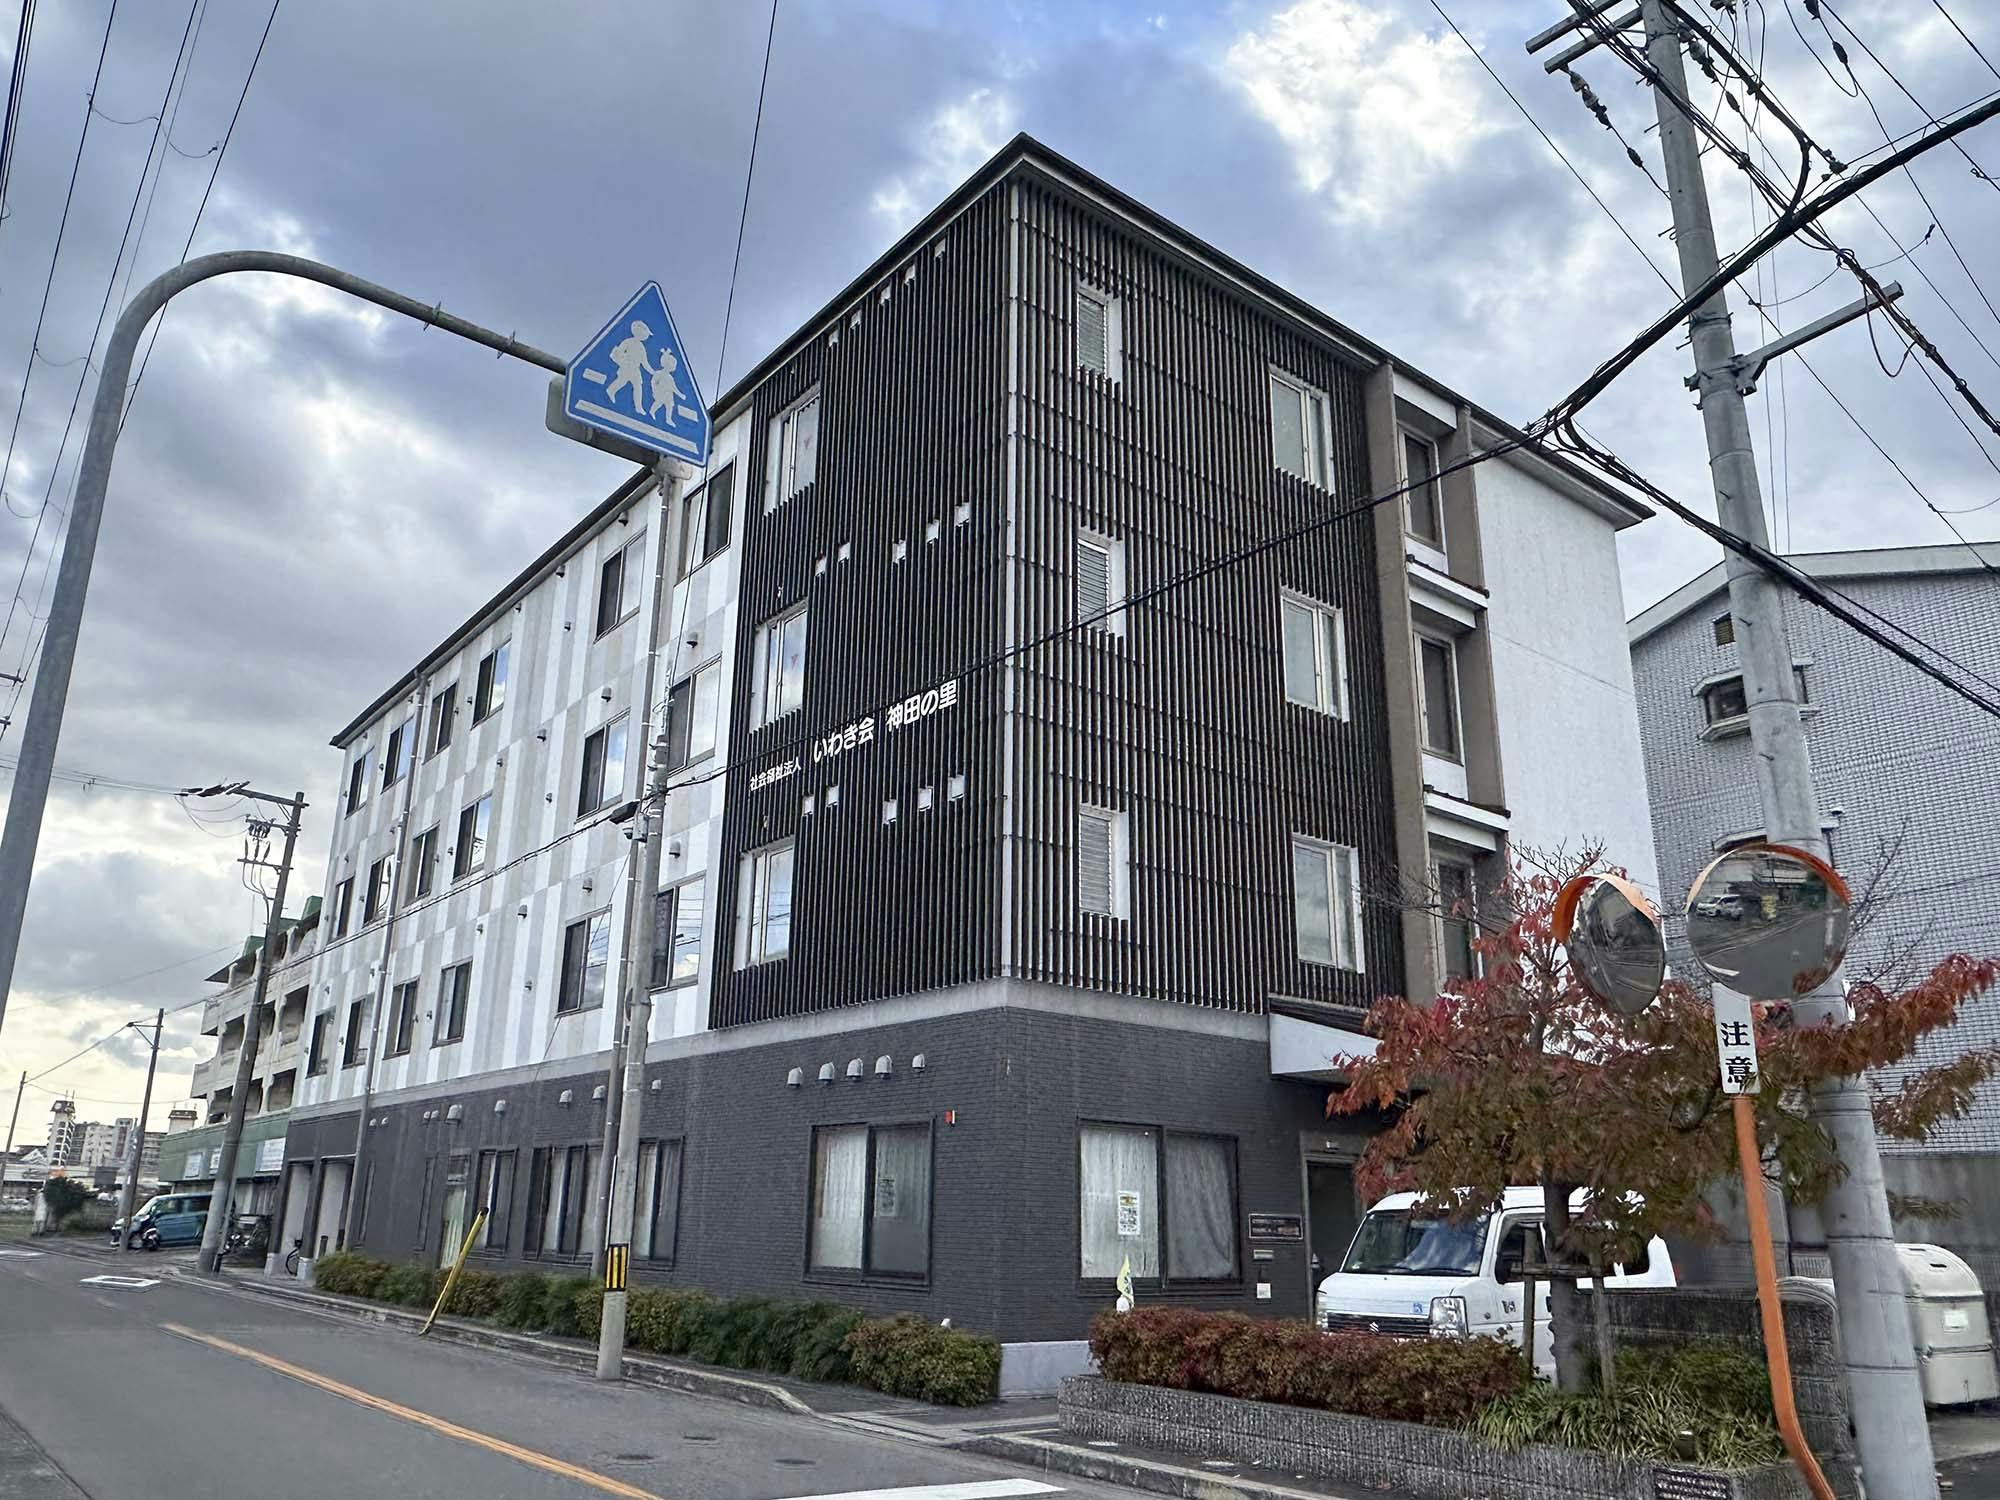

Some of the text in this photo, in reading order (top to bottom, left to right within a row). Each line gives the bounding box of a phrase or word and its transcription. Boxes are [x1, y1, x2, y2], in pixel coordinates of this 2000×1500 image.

[750, 679, 957, 791] 社会福祉法人 いわき会 神田の里
[1720, 1021, 1753, 1084] 注意
